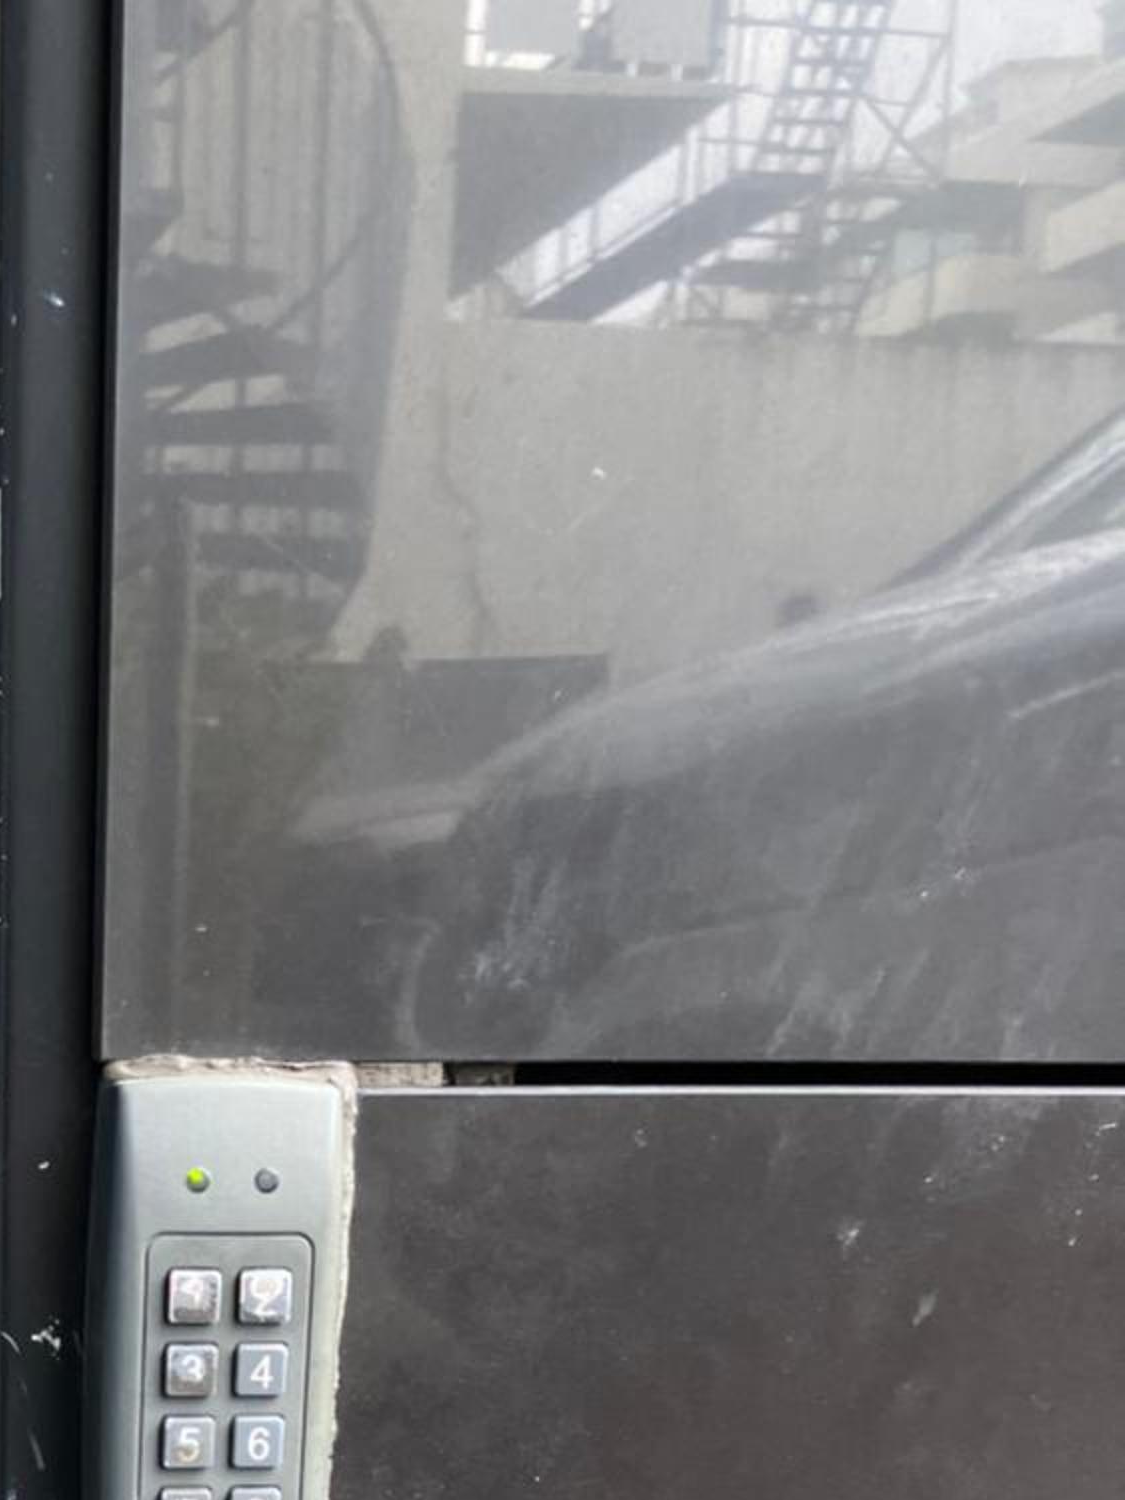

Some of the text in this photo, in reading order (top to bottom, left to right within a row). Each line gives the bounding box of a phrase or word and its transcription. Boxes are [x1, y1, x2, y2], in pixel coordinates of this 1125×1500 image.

[250, 1354, 275, 1390] 4
[177, 1426, 202, 1462] 5
[247, 1425, 271, 1461] 6
